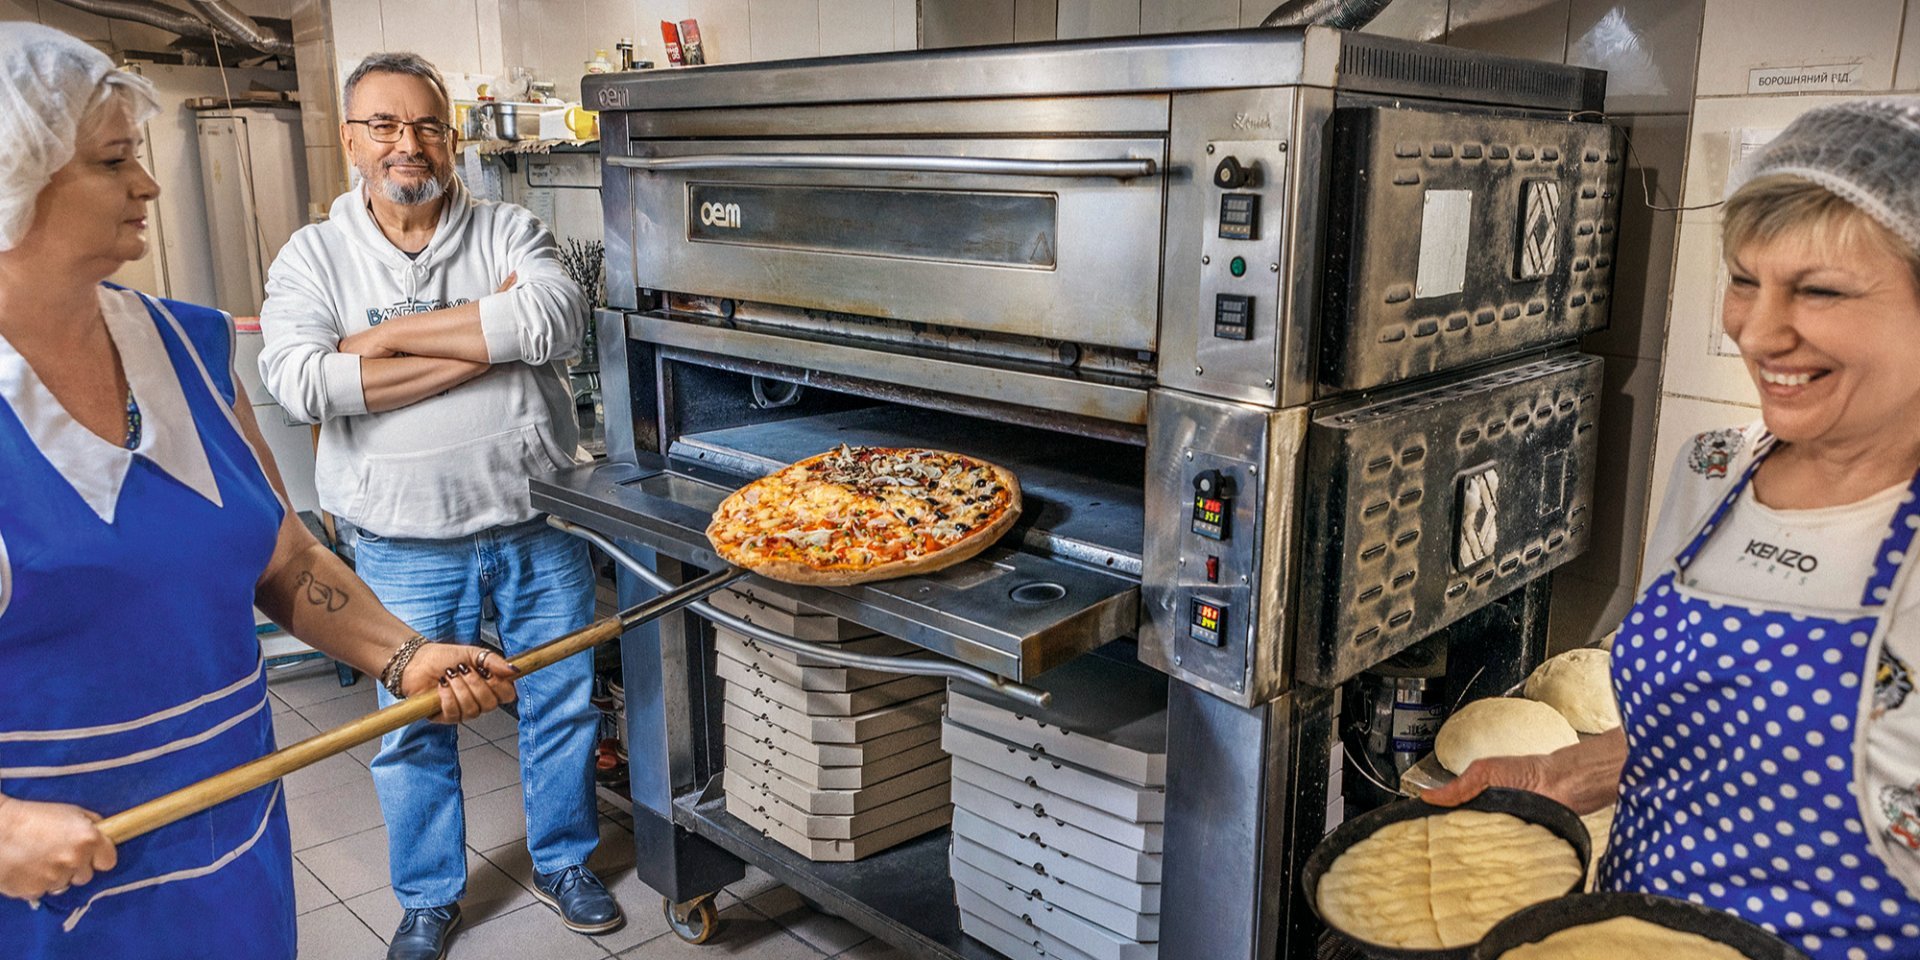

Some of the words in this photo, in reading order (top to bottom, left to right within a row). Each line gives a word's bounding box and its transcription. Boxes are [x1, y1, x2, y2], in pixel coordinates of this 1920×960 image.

[1758, 72, 1827, 86] БОРОШНЯНИЙ
[701, 201, 741, 228] oem
[1744, 539, 1818, 573] KENZO
